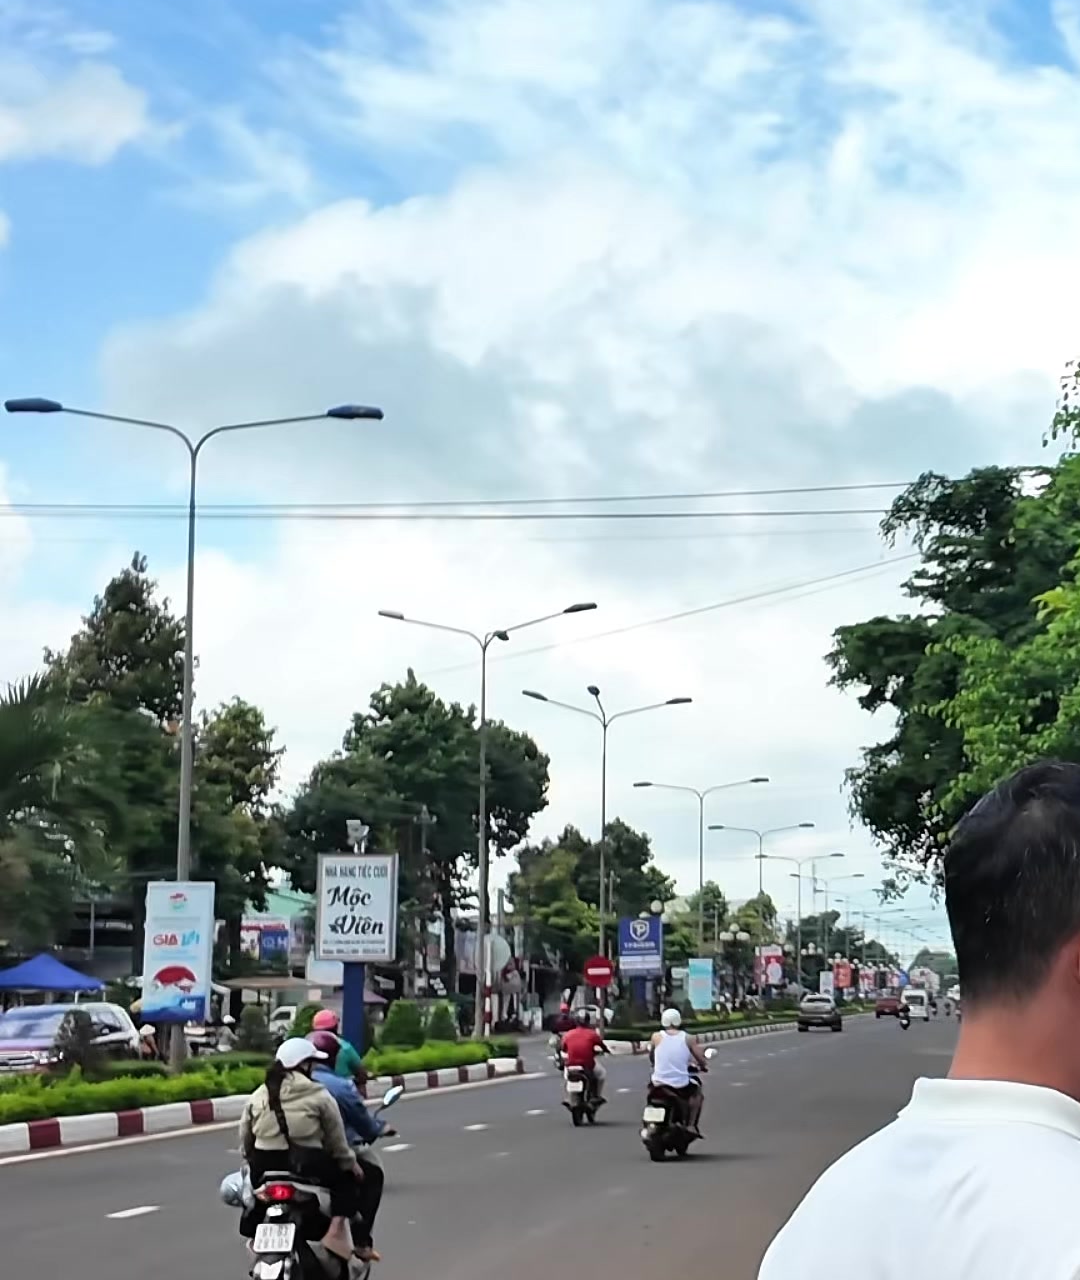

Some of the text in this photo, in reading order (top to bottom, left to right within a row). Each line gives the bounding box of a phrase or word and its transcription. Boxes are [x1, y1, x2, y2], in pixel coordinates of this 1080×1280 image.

[327, 885, 371, 912] Mộc
[333, 914, 384, 935] Viên
[153, 933, 178, 946] GIA
